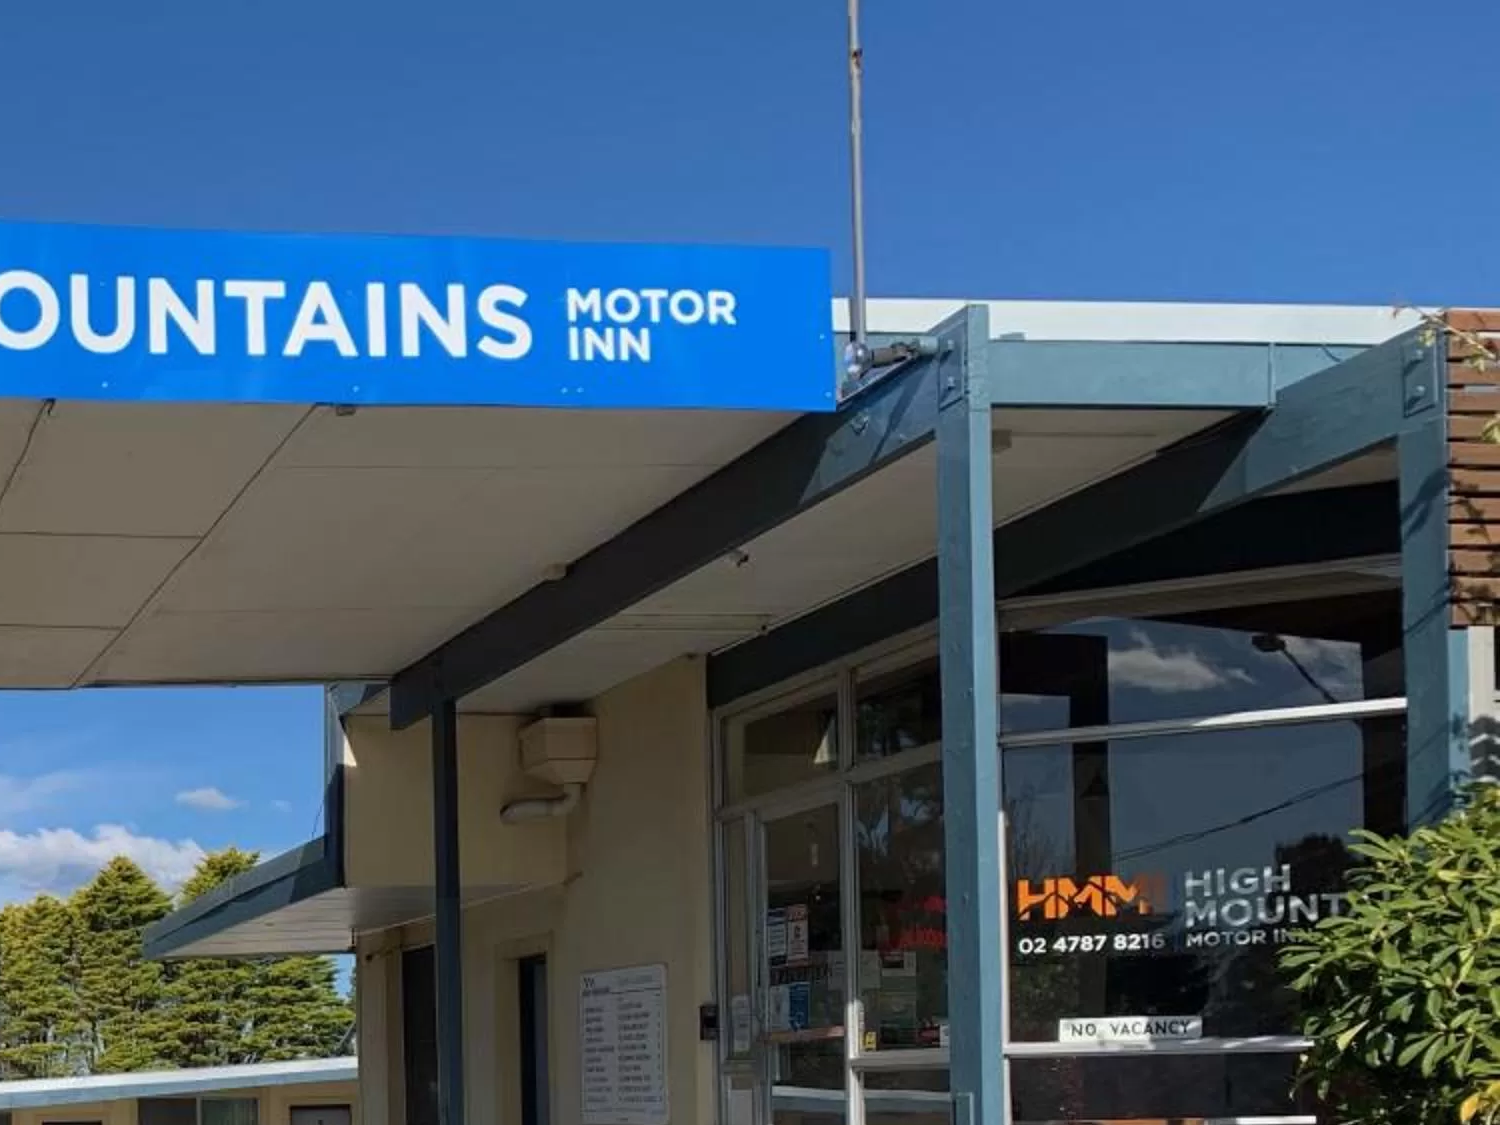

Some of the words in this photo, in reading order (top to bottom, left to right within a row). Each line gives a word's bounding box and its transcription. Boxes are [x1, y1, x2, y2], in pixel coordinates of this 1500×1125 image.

[567, 287, 736, 325] MOTOR
[568, 327, 650, 361] INN
[1185, 864, 1291, 897] HIGH
[1184, 893, 1358, 929] MOUNT
[1018, 937, 1047, 954] 02
[1052, 934, 1107, 953] 4787
[1113, 932, 1166, 952] 8216
[1186, 929, 1266, 947] MOTOR
[1273, 927, 1312, 944] IN
[1071, 1023, 1097, 1037] NO
[1110, 1020, 1190, 1036] VACANCY
